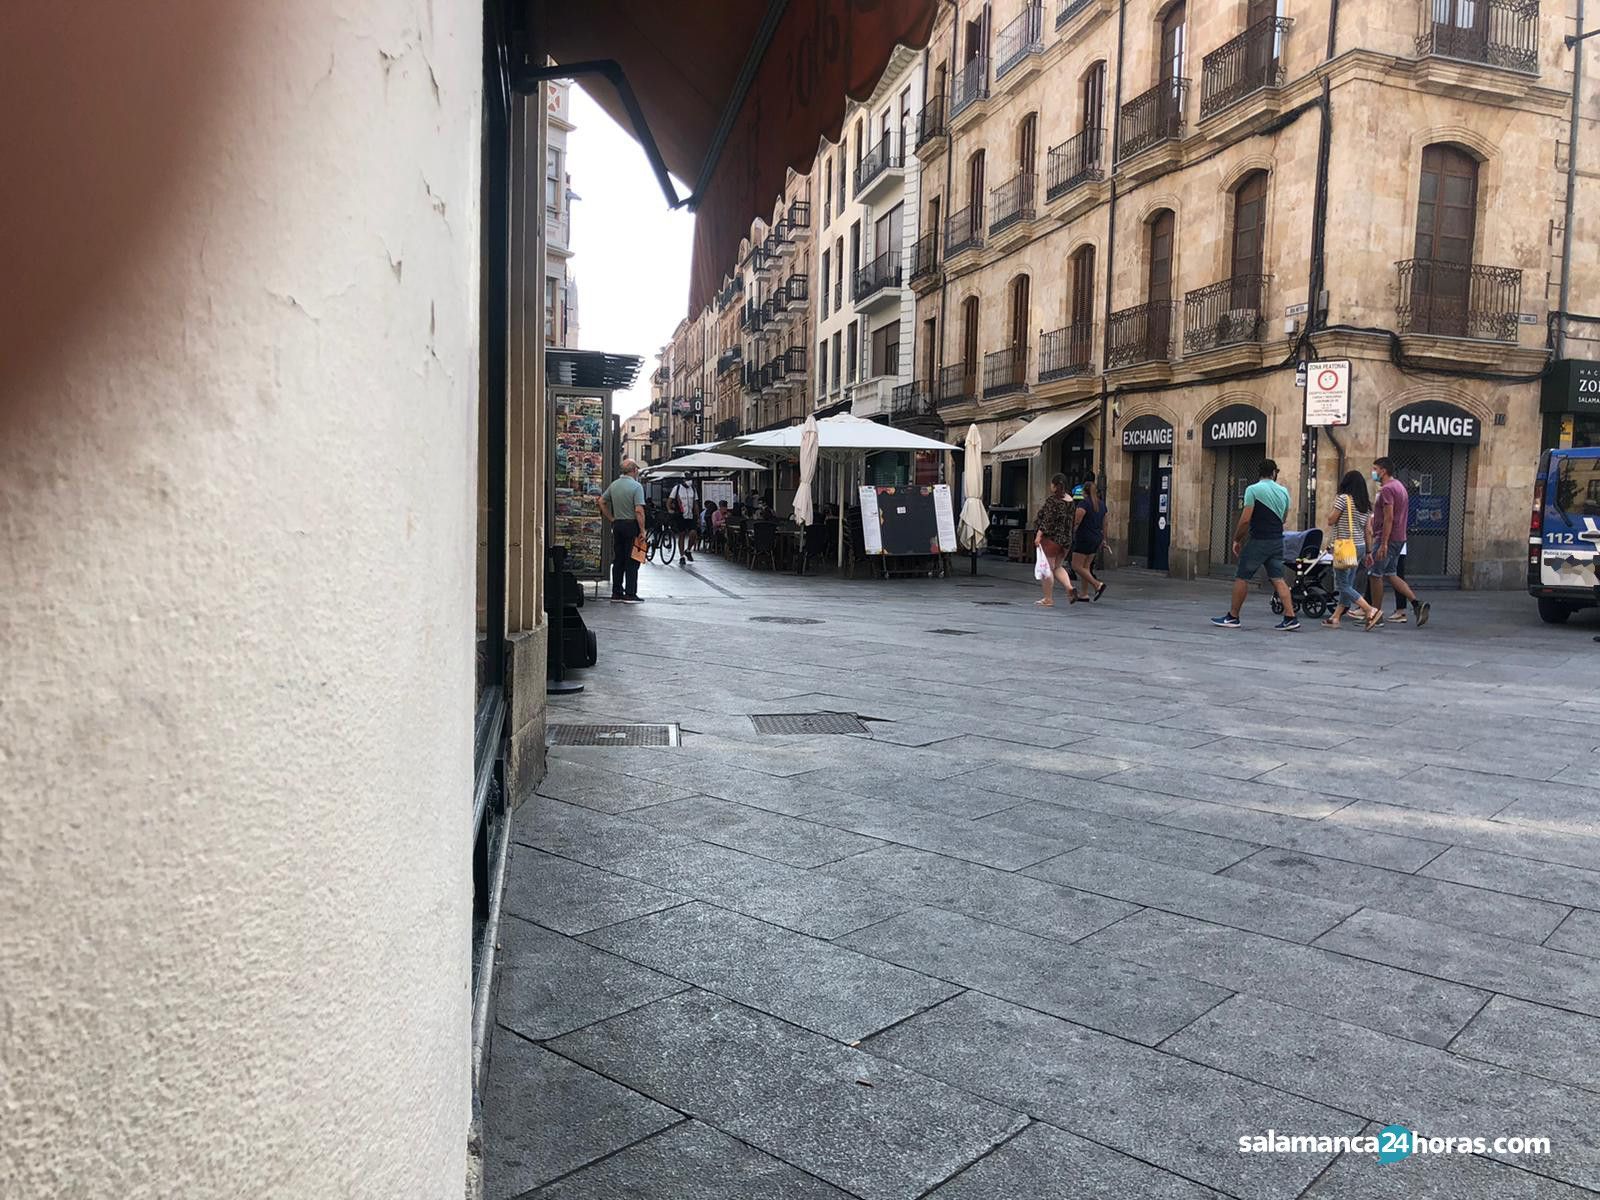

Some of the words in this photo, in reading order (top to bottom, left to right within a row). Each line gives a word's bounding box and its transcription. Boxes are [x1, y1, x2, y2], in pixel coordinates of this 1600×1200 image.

[1579, 379, 1600, 393] ZO
[1211, 420, 1257, 440] CAMBIO
[1397, 414, 1474, 437] CHANGE
[1123, 428, 1173, 446] EXCHANGE
[1546, 532, 1574, 544] 112
